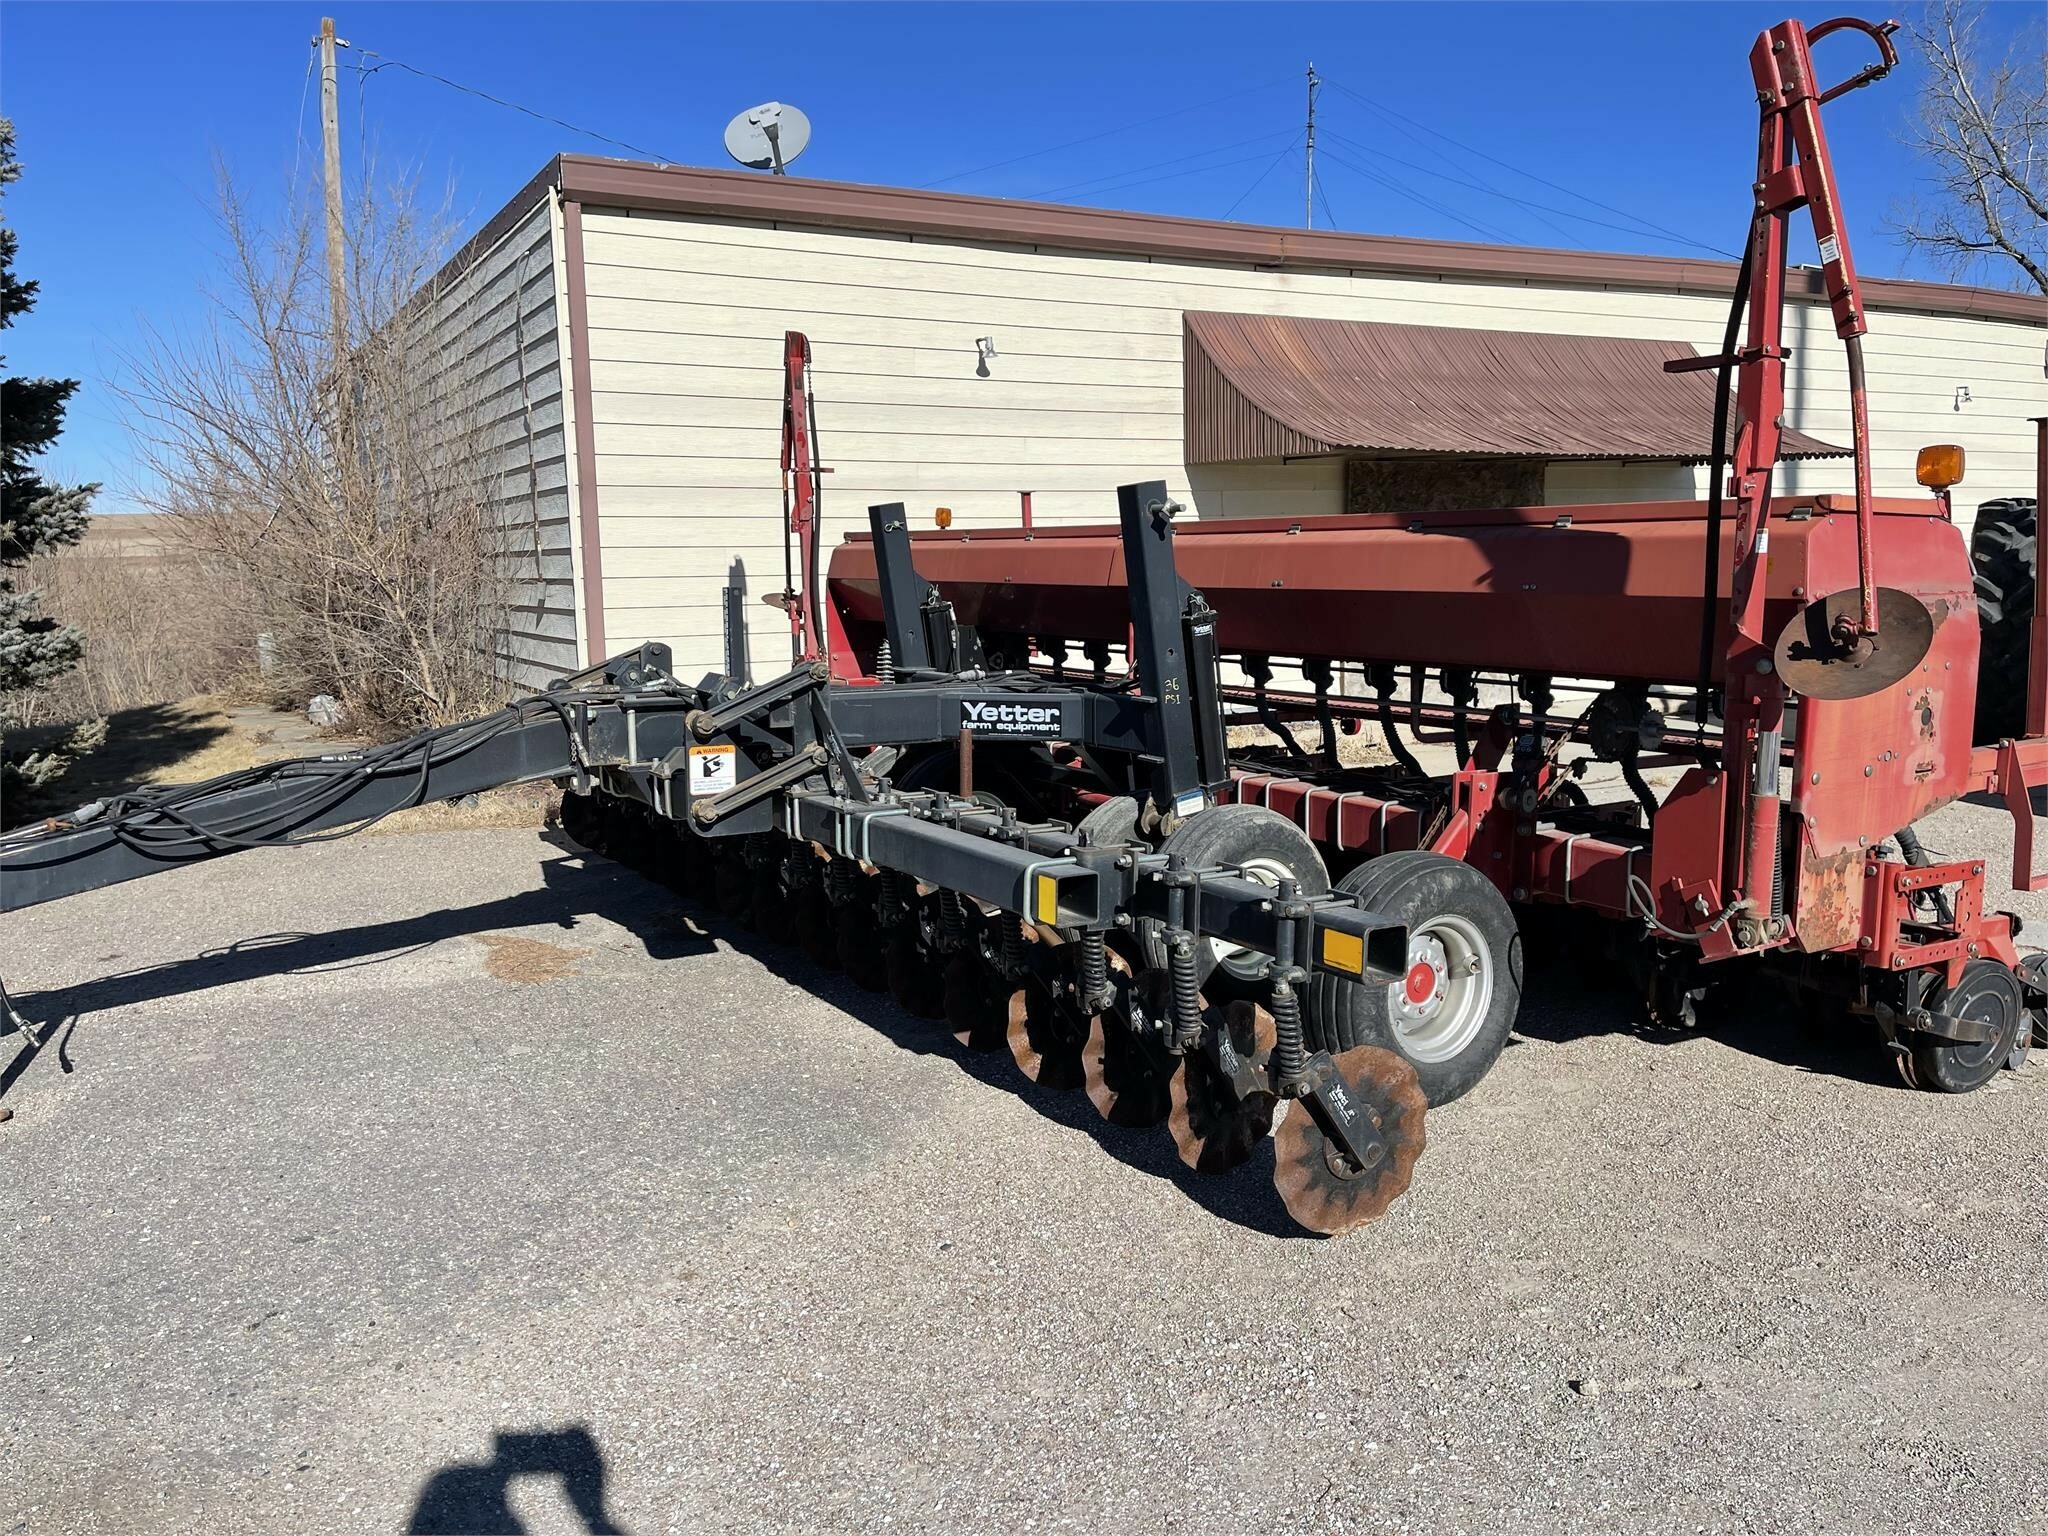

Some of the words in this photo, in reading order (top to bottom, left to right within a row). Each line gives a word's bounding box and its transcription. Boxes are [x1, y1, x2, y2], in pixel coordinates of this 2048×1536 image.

[1164, 677, 1180, 692] 36
[1165, 694, 1181, 705] PSI
[962, 701, 1060, 722] Yetter
[962, 720, 992, 730] farm
[996, 721, 1060, 732] equipment
